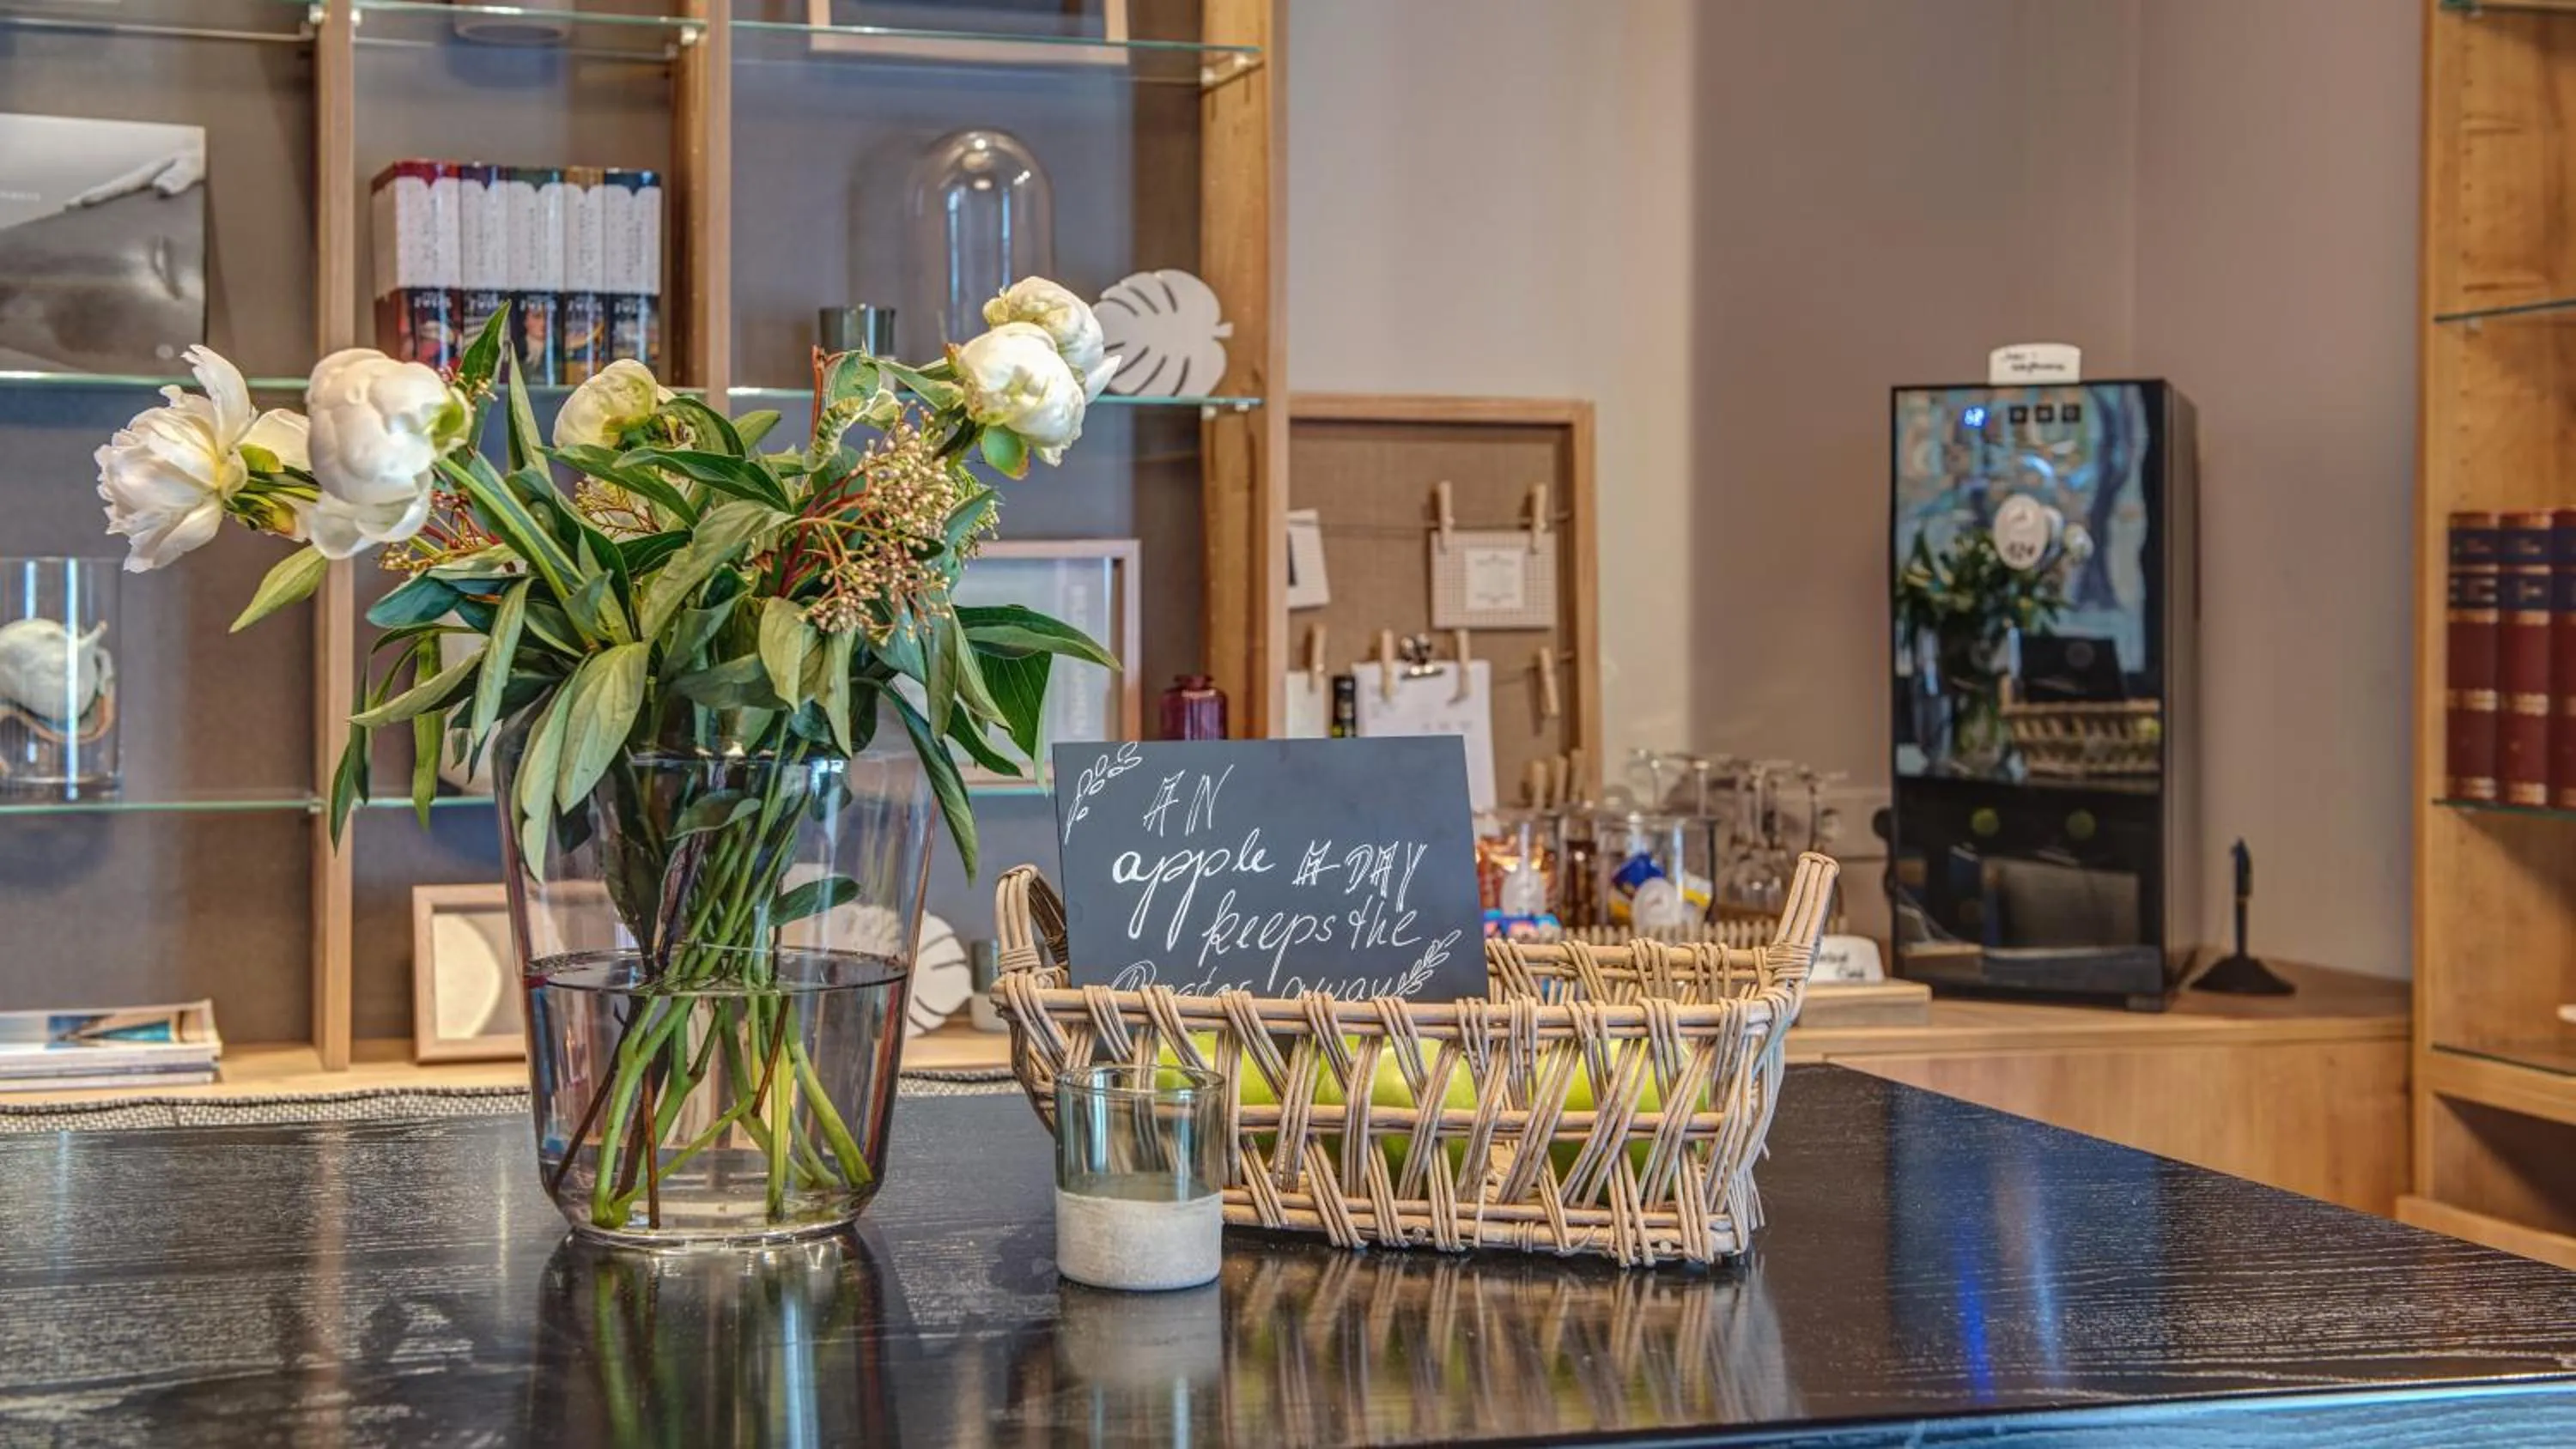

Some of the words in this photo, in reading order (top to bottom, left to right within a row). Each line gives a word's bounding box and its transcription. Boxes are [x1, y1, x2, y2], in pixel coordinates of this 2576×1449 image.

[1143, 763, 1234, 838] AN
[1112, 827, 1276, 951] apple
[1344, 840, 1428, 912] DAY
[1197, 888, 1337, 991] keeps
[1347, 894, 1422, 950] the
